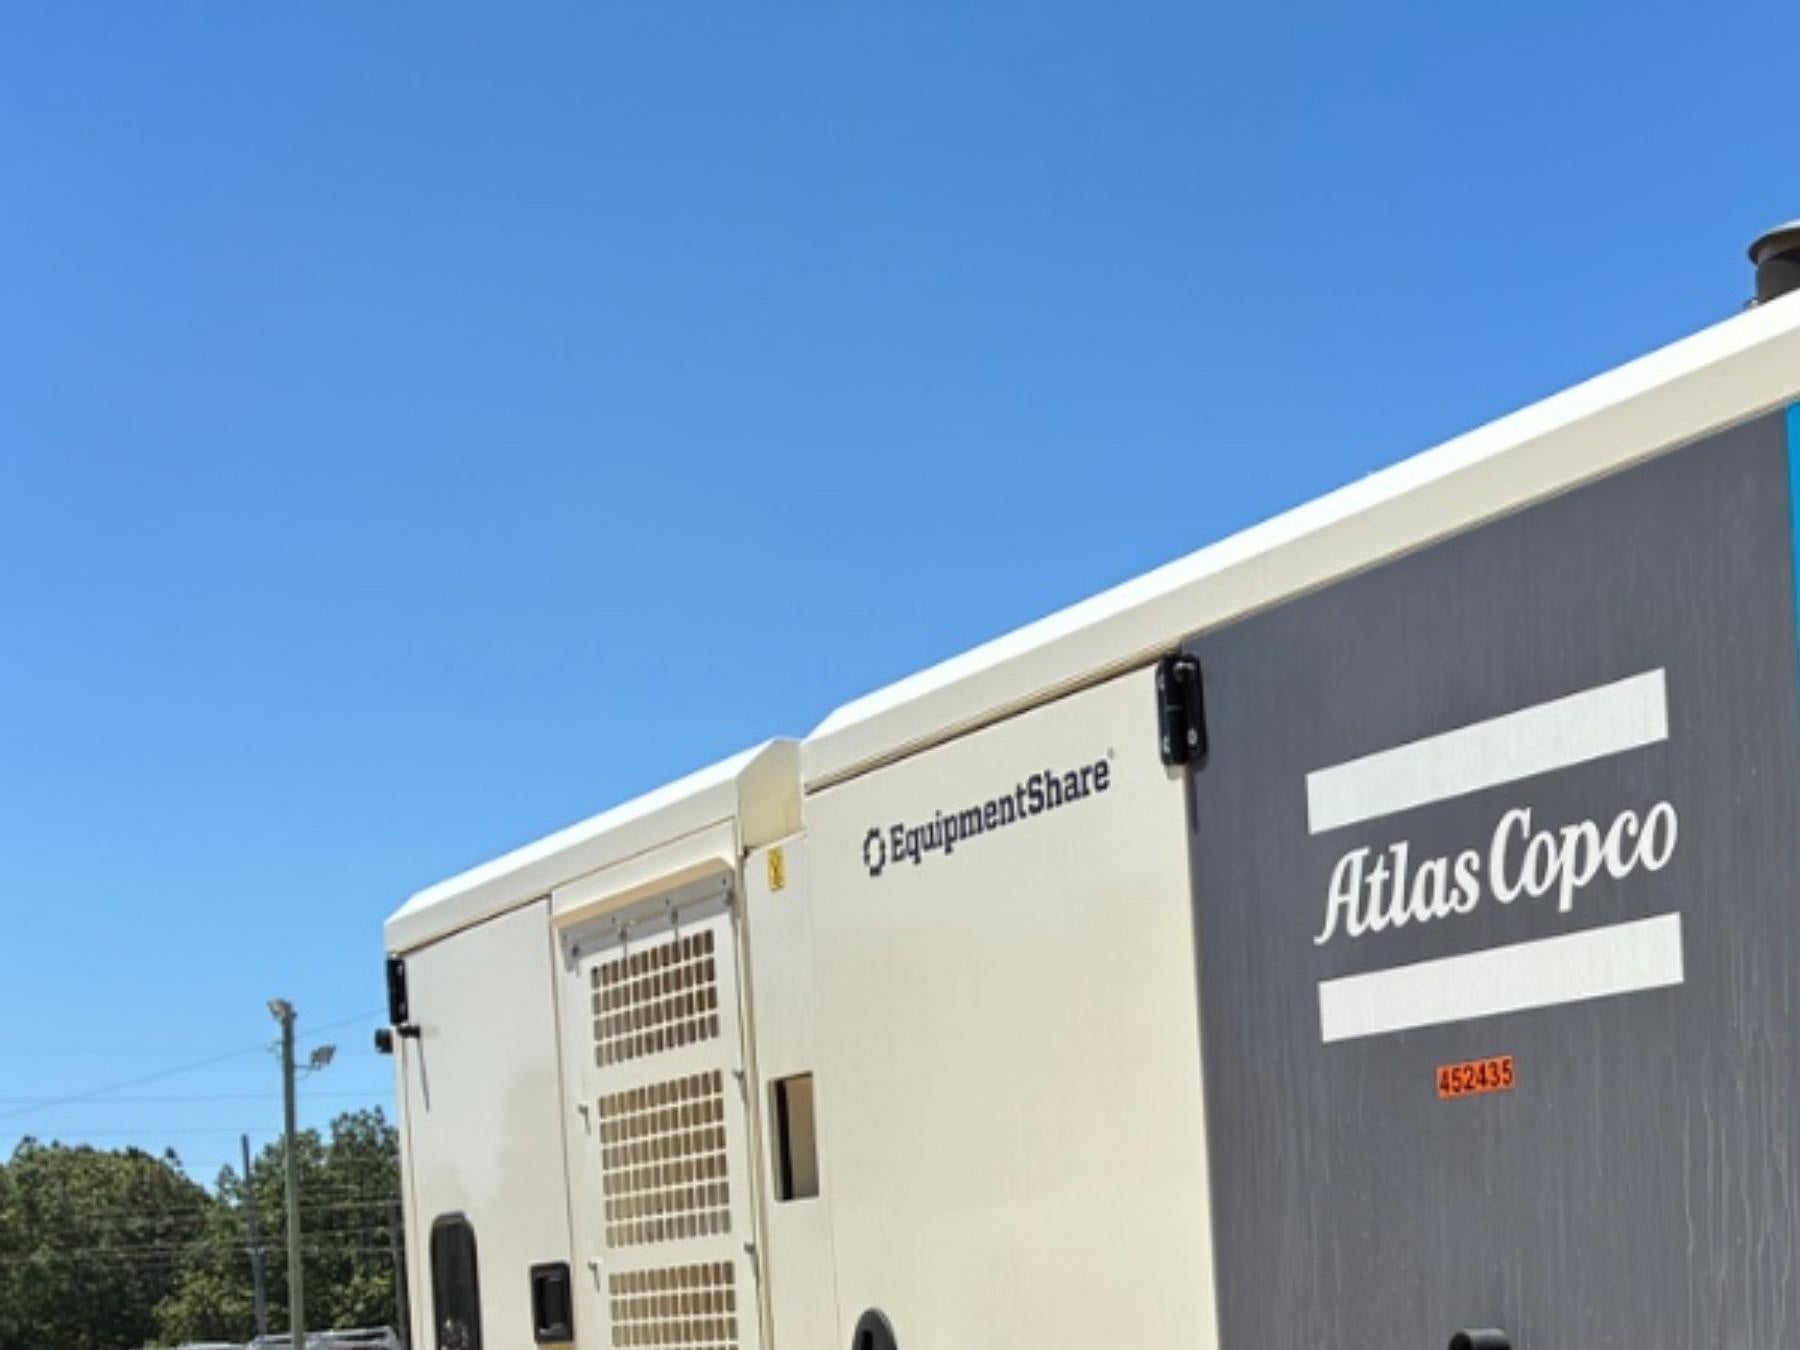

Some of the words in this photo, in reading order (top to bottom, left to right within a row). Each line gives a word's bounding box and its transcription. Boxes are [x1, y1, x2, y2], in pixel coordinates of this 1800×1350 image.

[889, 757, 1110, 864] EquipmentShare
[1312, 841, 1481, 945] Atlas
[1489, 800, 1679, 912] Copco
[1439, 1058, 1512, 1093] 452435
